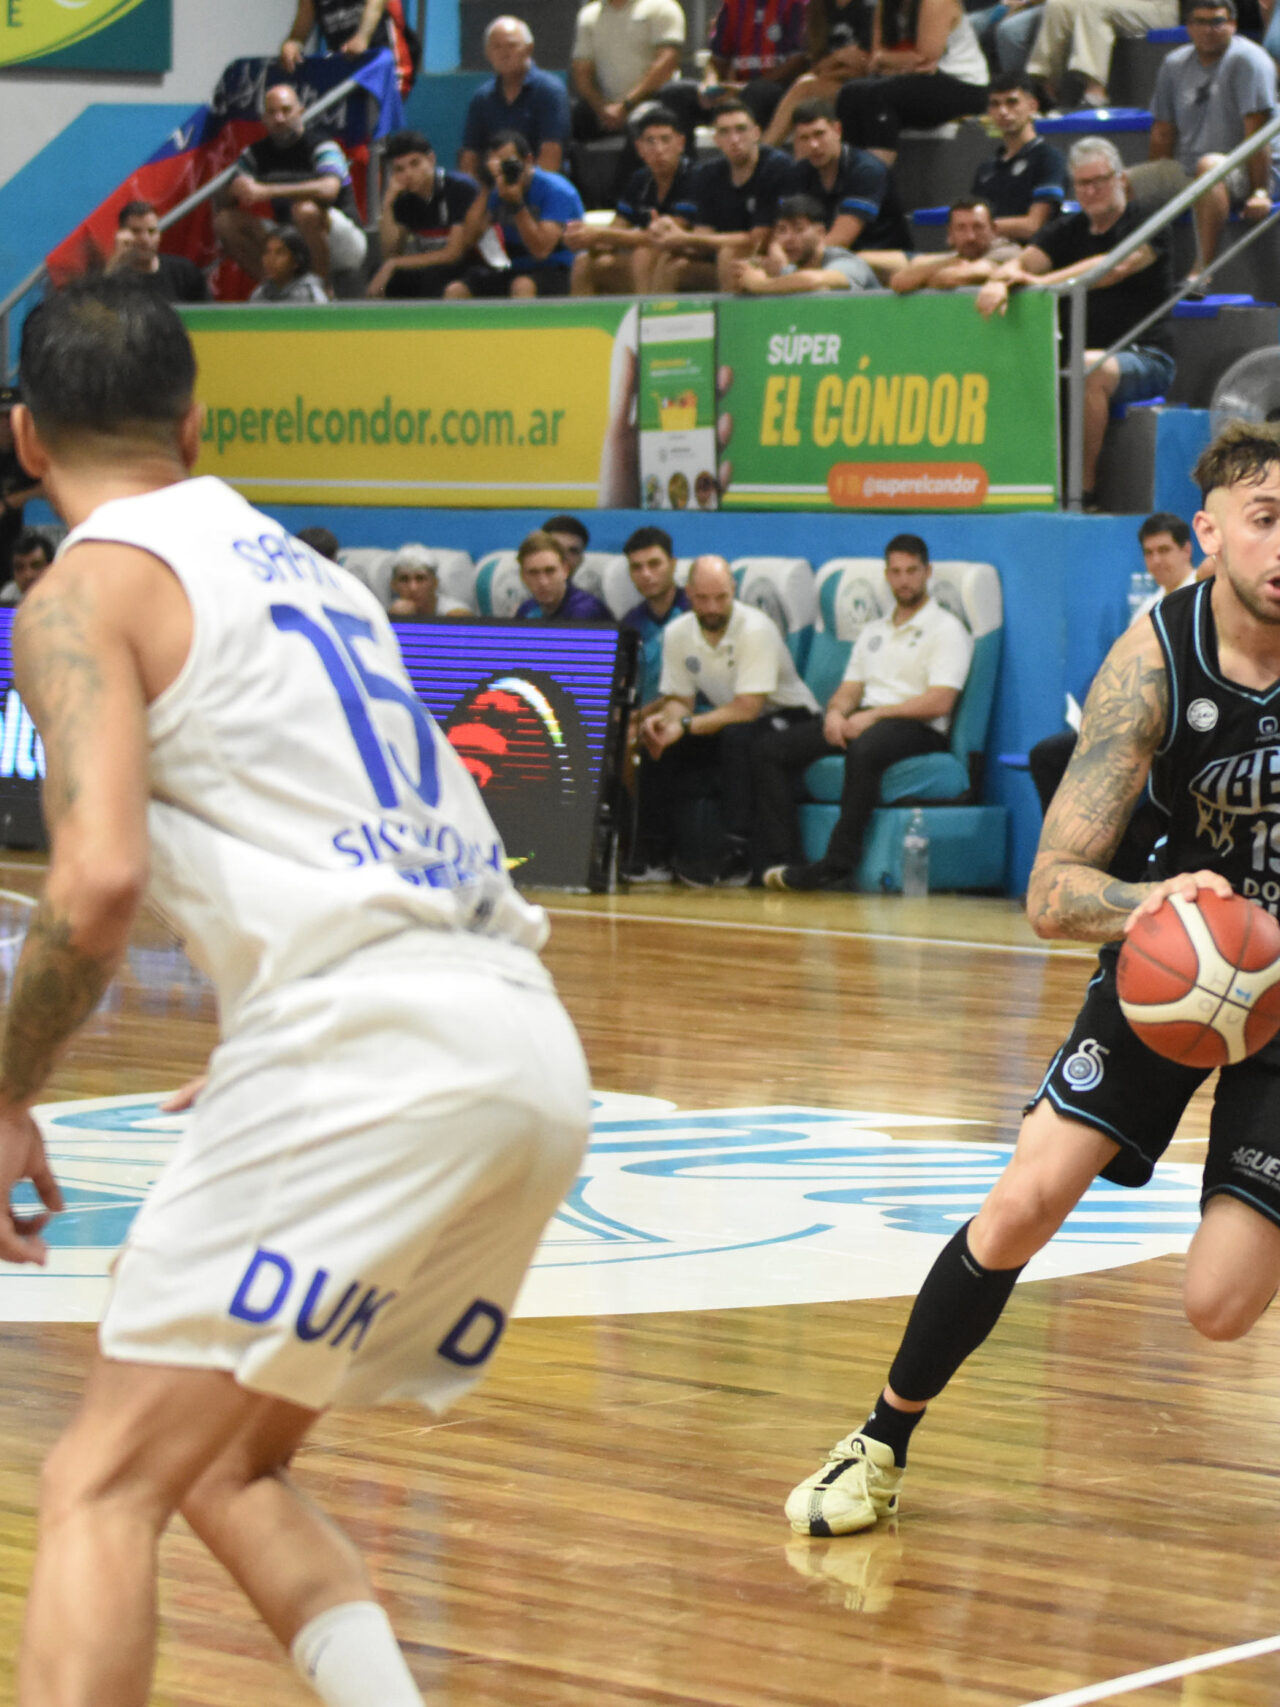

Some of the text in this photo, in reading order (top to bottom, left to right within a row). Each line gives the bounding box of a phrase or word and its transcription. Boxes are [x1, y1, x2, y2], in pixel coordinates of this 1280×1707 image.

[767, 325, 842, 366] SÚPER
[759, 354, 990, 448] EL CÓNDOR
[269, 603, 440, 809] 15
